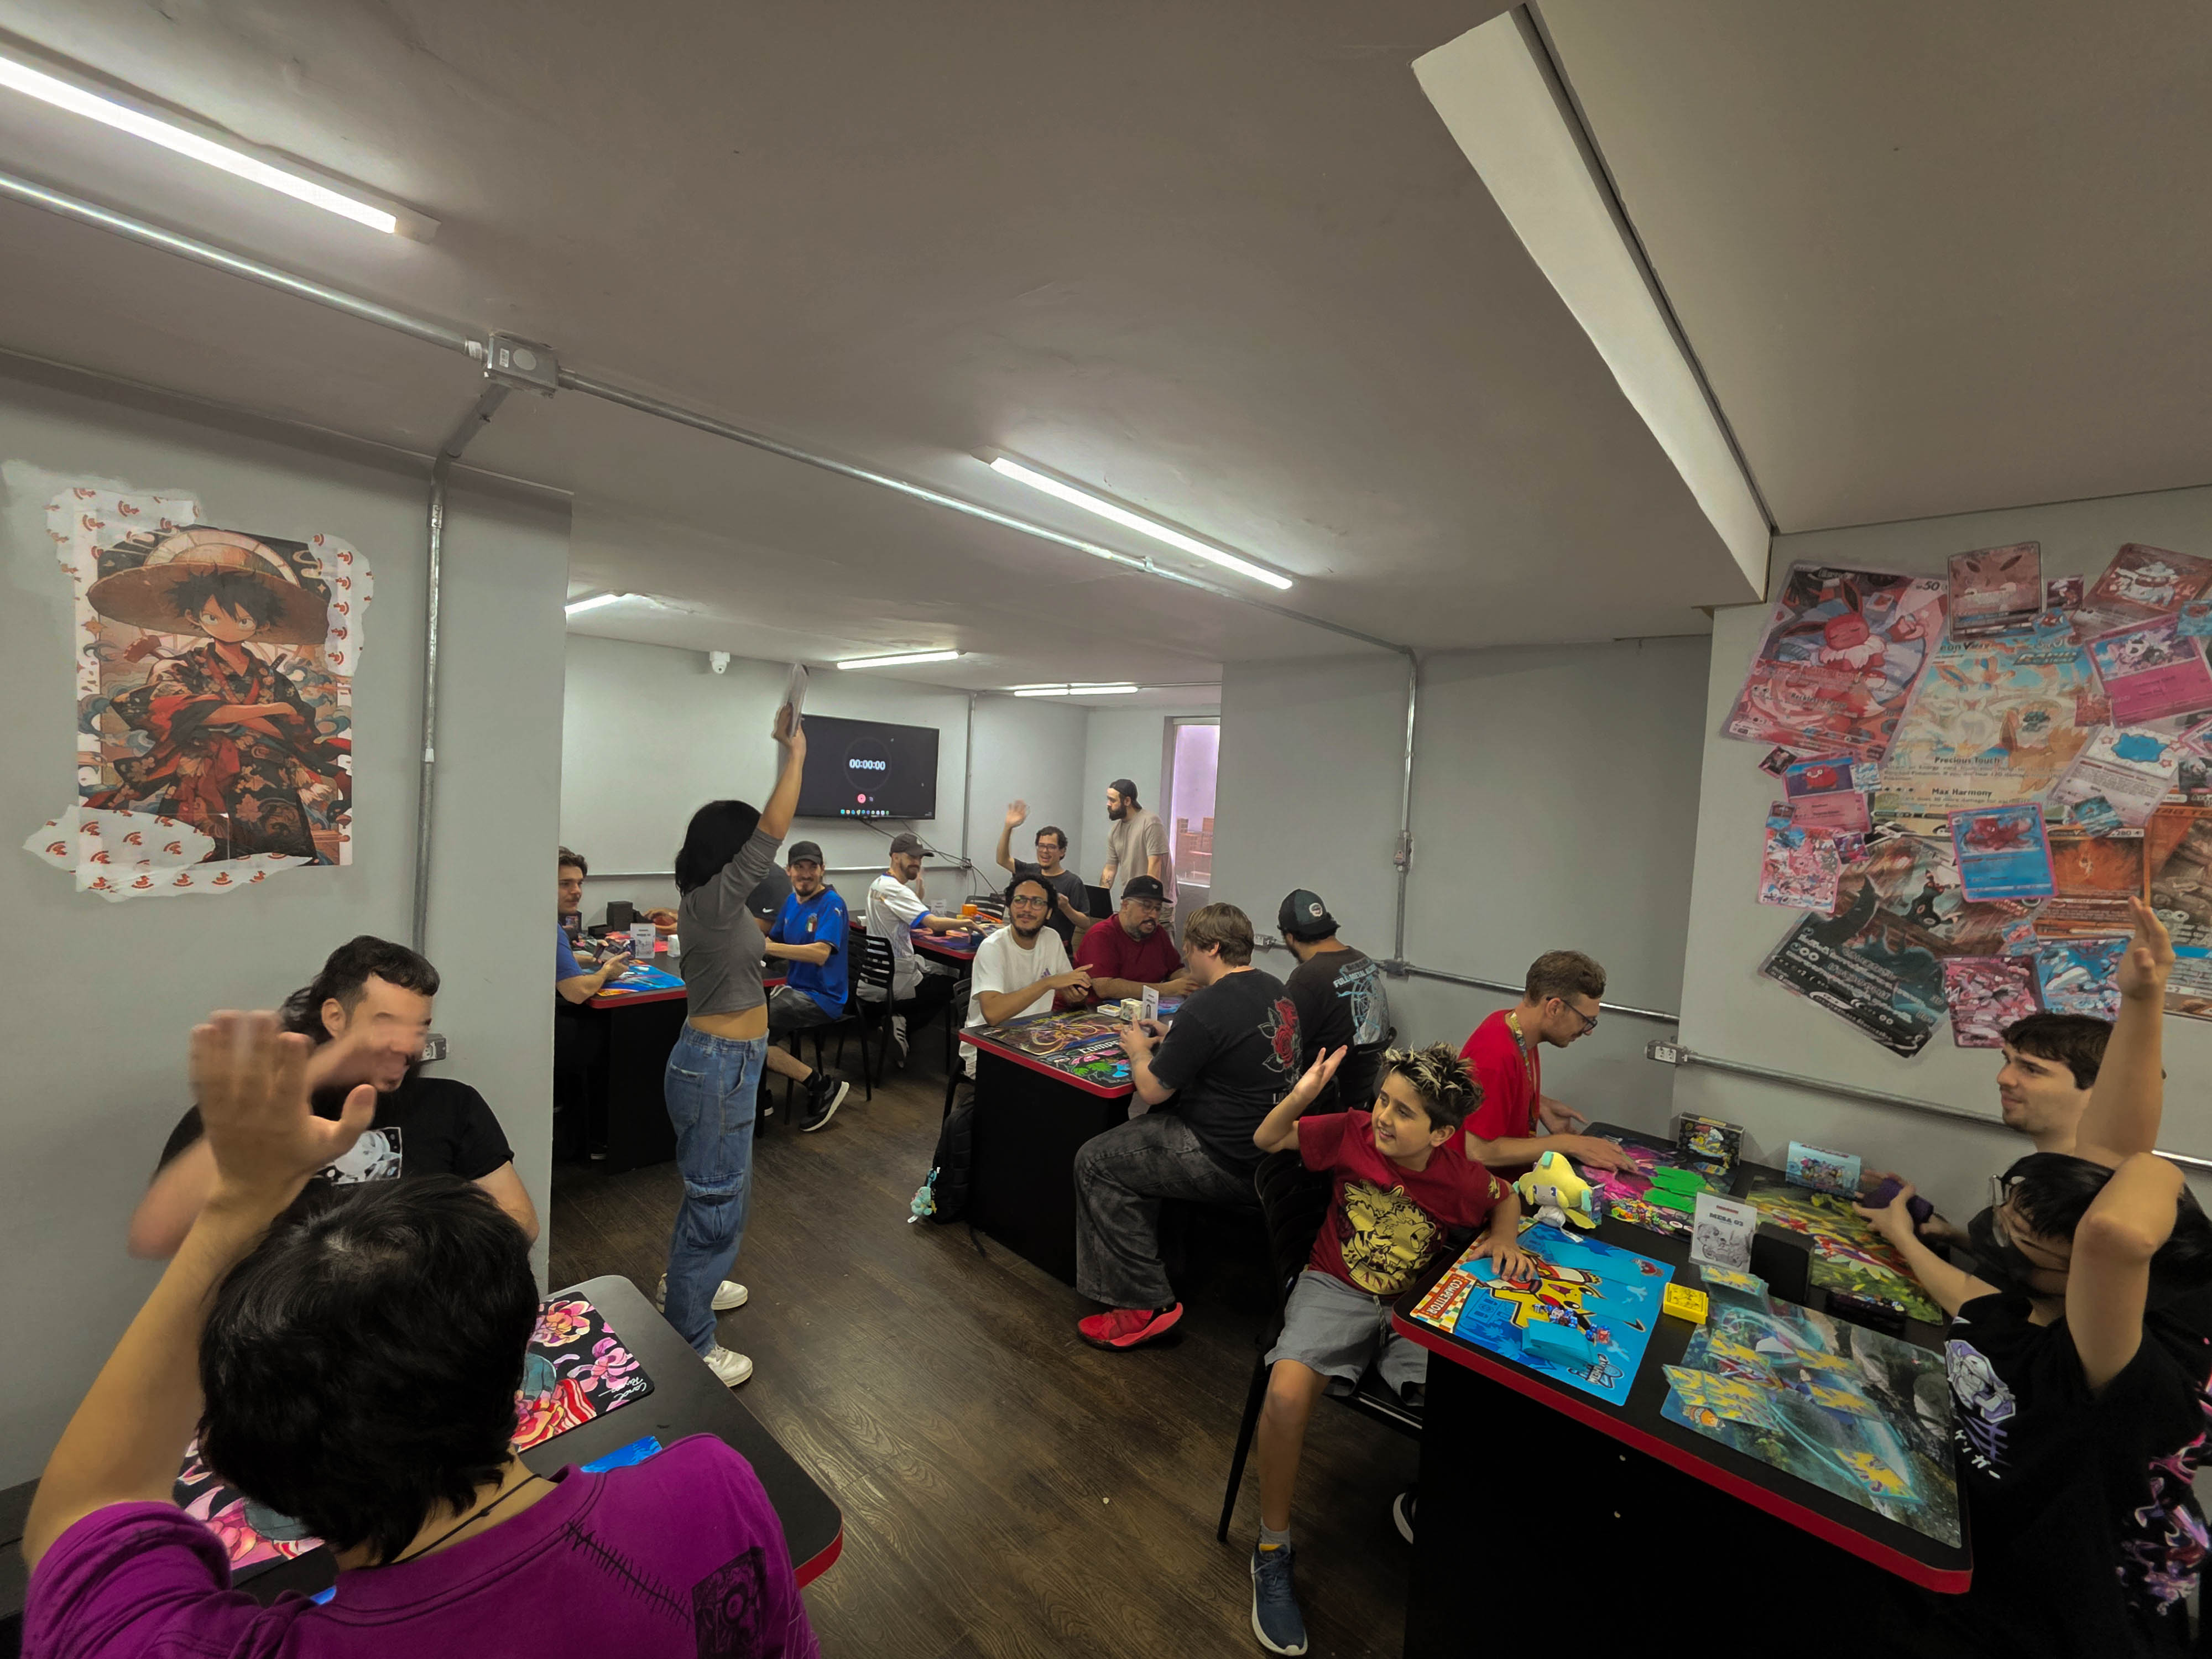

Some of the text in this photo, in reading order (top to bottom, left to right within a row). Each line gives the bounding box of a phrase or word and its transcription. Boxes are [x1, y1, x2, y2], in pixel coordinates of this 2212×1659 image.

[849, 758, 886, 770] 00:00:00
[1935, 756, 1971, 764] Precious
[1952, 787, 1993, 798] Harmony
[1709, 1212, 1732, 1223] MESA
[1426, 1279, 1463, 1314] COMPETITOR
